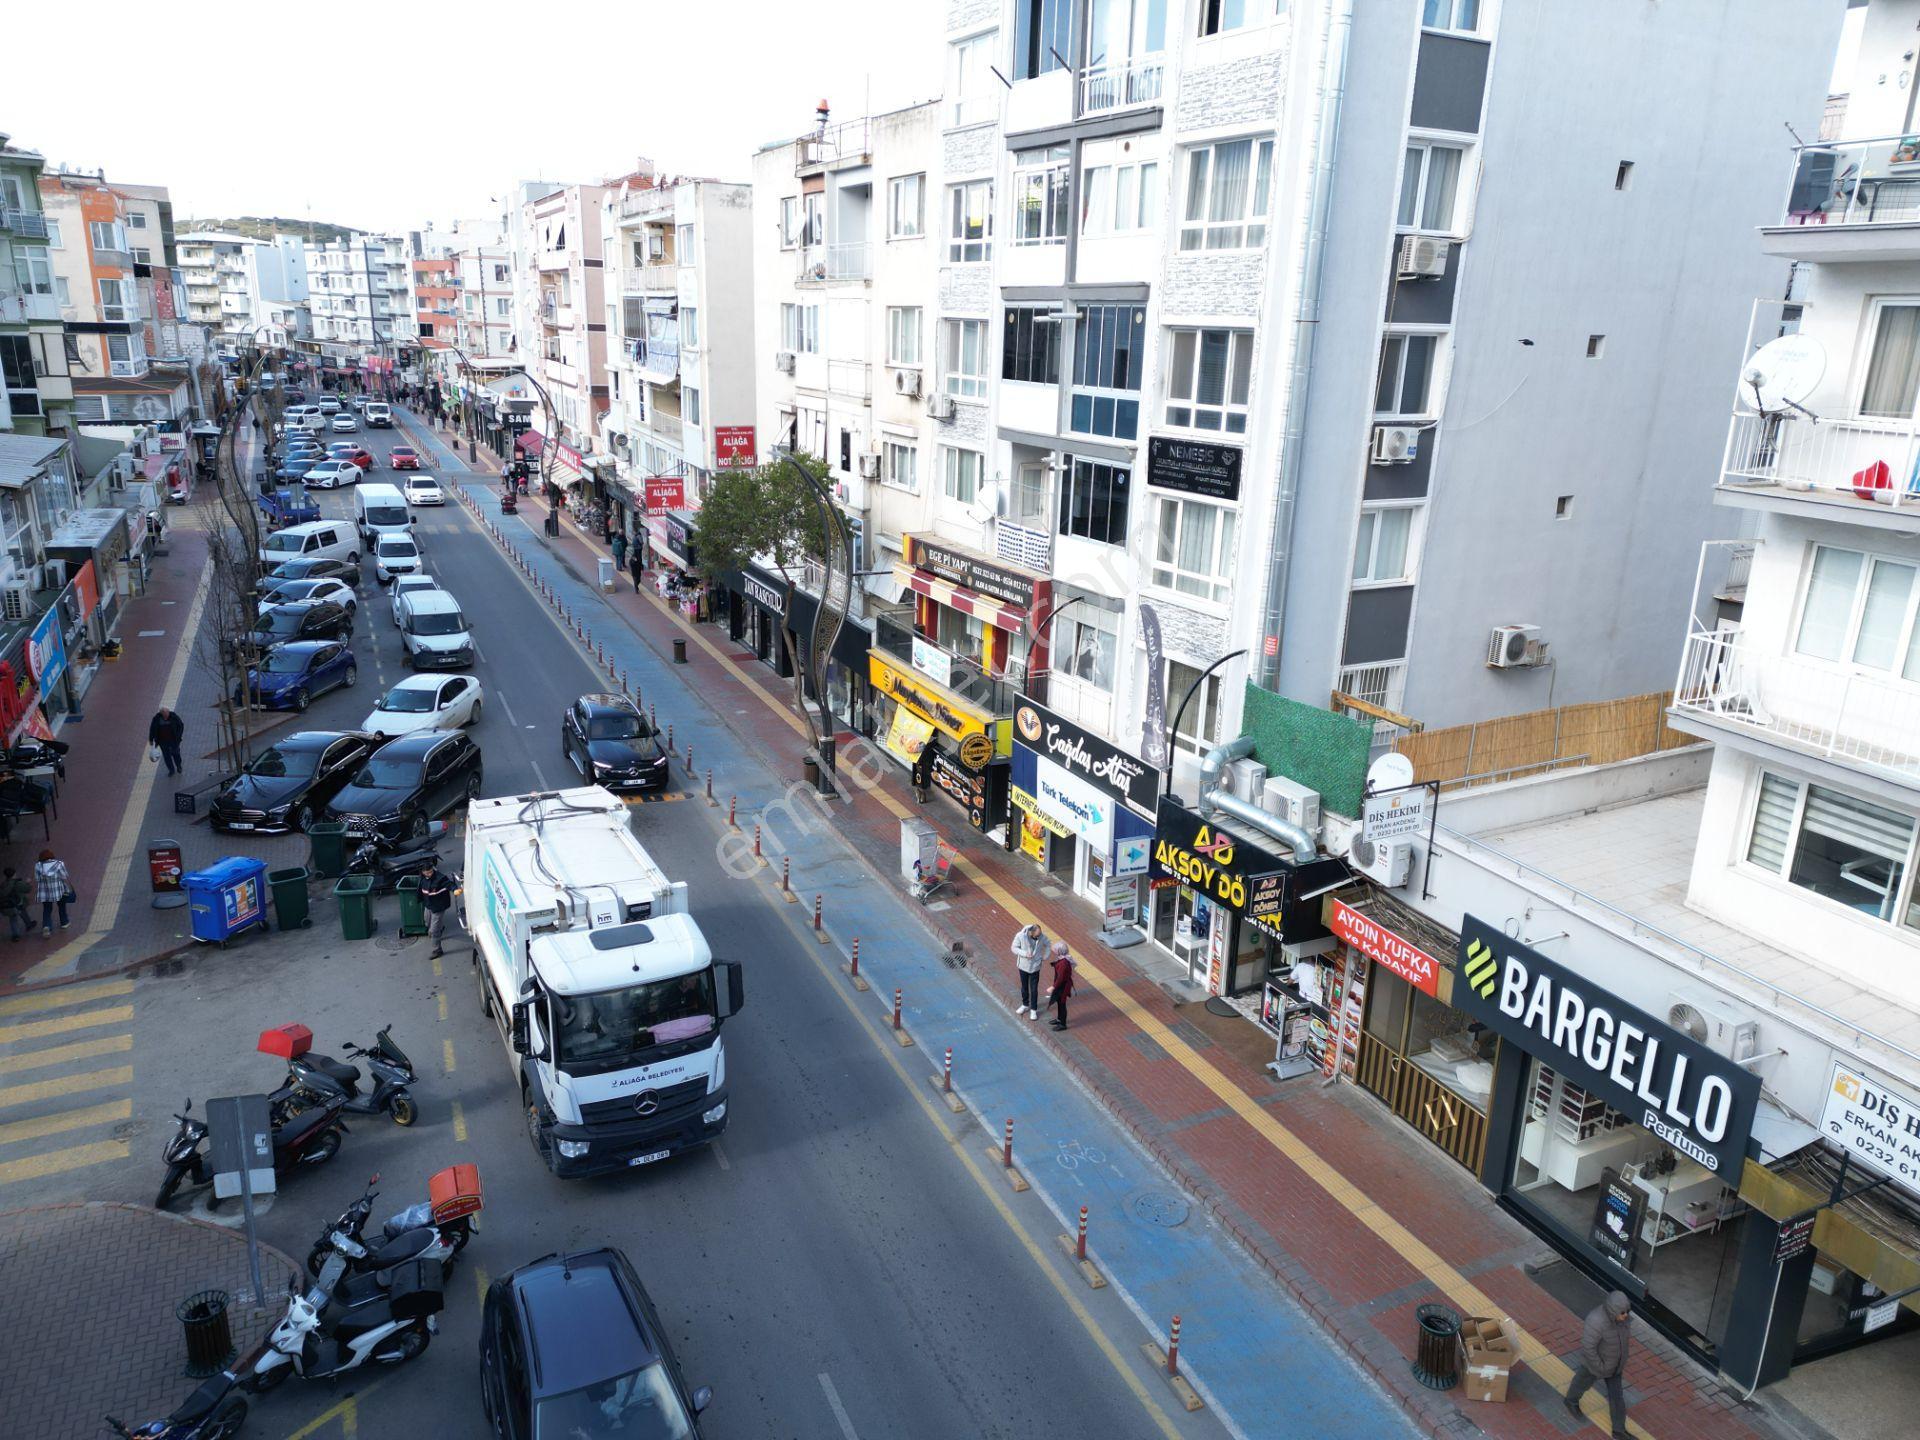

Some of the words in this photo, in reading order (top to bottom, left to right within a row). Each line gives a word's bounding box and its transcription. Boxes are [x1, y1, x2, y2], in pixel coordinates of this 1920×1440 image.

[723, 436, 748, 446] ALİAĞA
[652, 487, 678, 497] ALİAĞA
[928, 549, 943, 562] EGE
[951, 557, 968, 572] YAPI
[1046, 722, 1092, 773] Çağdaş
[1093, 754, 1133, 796] Ataş
[1041, 780, 1056, 799] Türk
[1058, 792, 1089, 820] Telekom
[1368, 810, 1385, 823] DİŞ
[1386, 803, 1421, 819] HEKİMİ
[1155, 839, 1216, 889] AKSOY
[1155, 879, 1182, 889] AKSO
[1253, 900, 1279, 914] DÖNER
[1254, 888, 1281, 902] AKSOY
[1337, 909, 1378, 944] AYDIN
[1382, 934, 1432, 978] YUFKA
[1345, 931, 1359, 945] ve
[1362, 940, 1423, 983] KADAYIF
[1499, 955, 1732, 1143] BARGELLO
[1860, 1088, 1900, 1129] DİŞ
[1643, 1108, 1719, 1171] Perfume
[1844, 1110, 1897, 1148] ERKAN
[1856, 1136, 1895, 1166] 0232
[1899, 1162, 1920, 1181] 61
